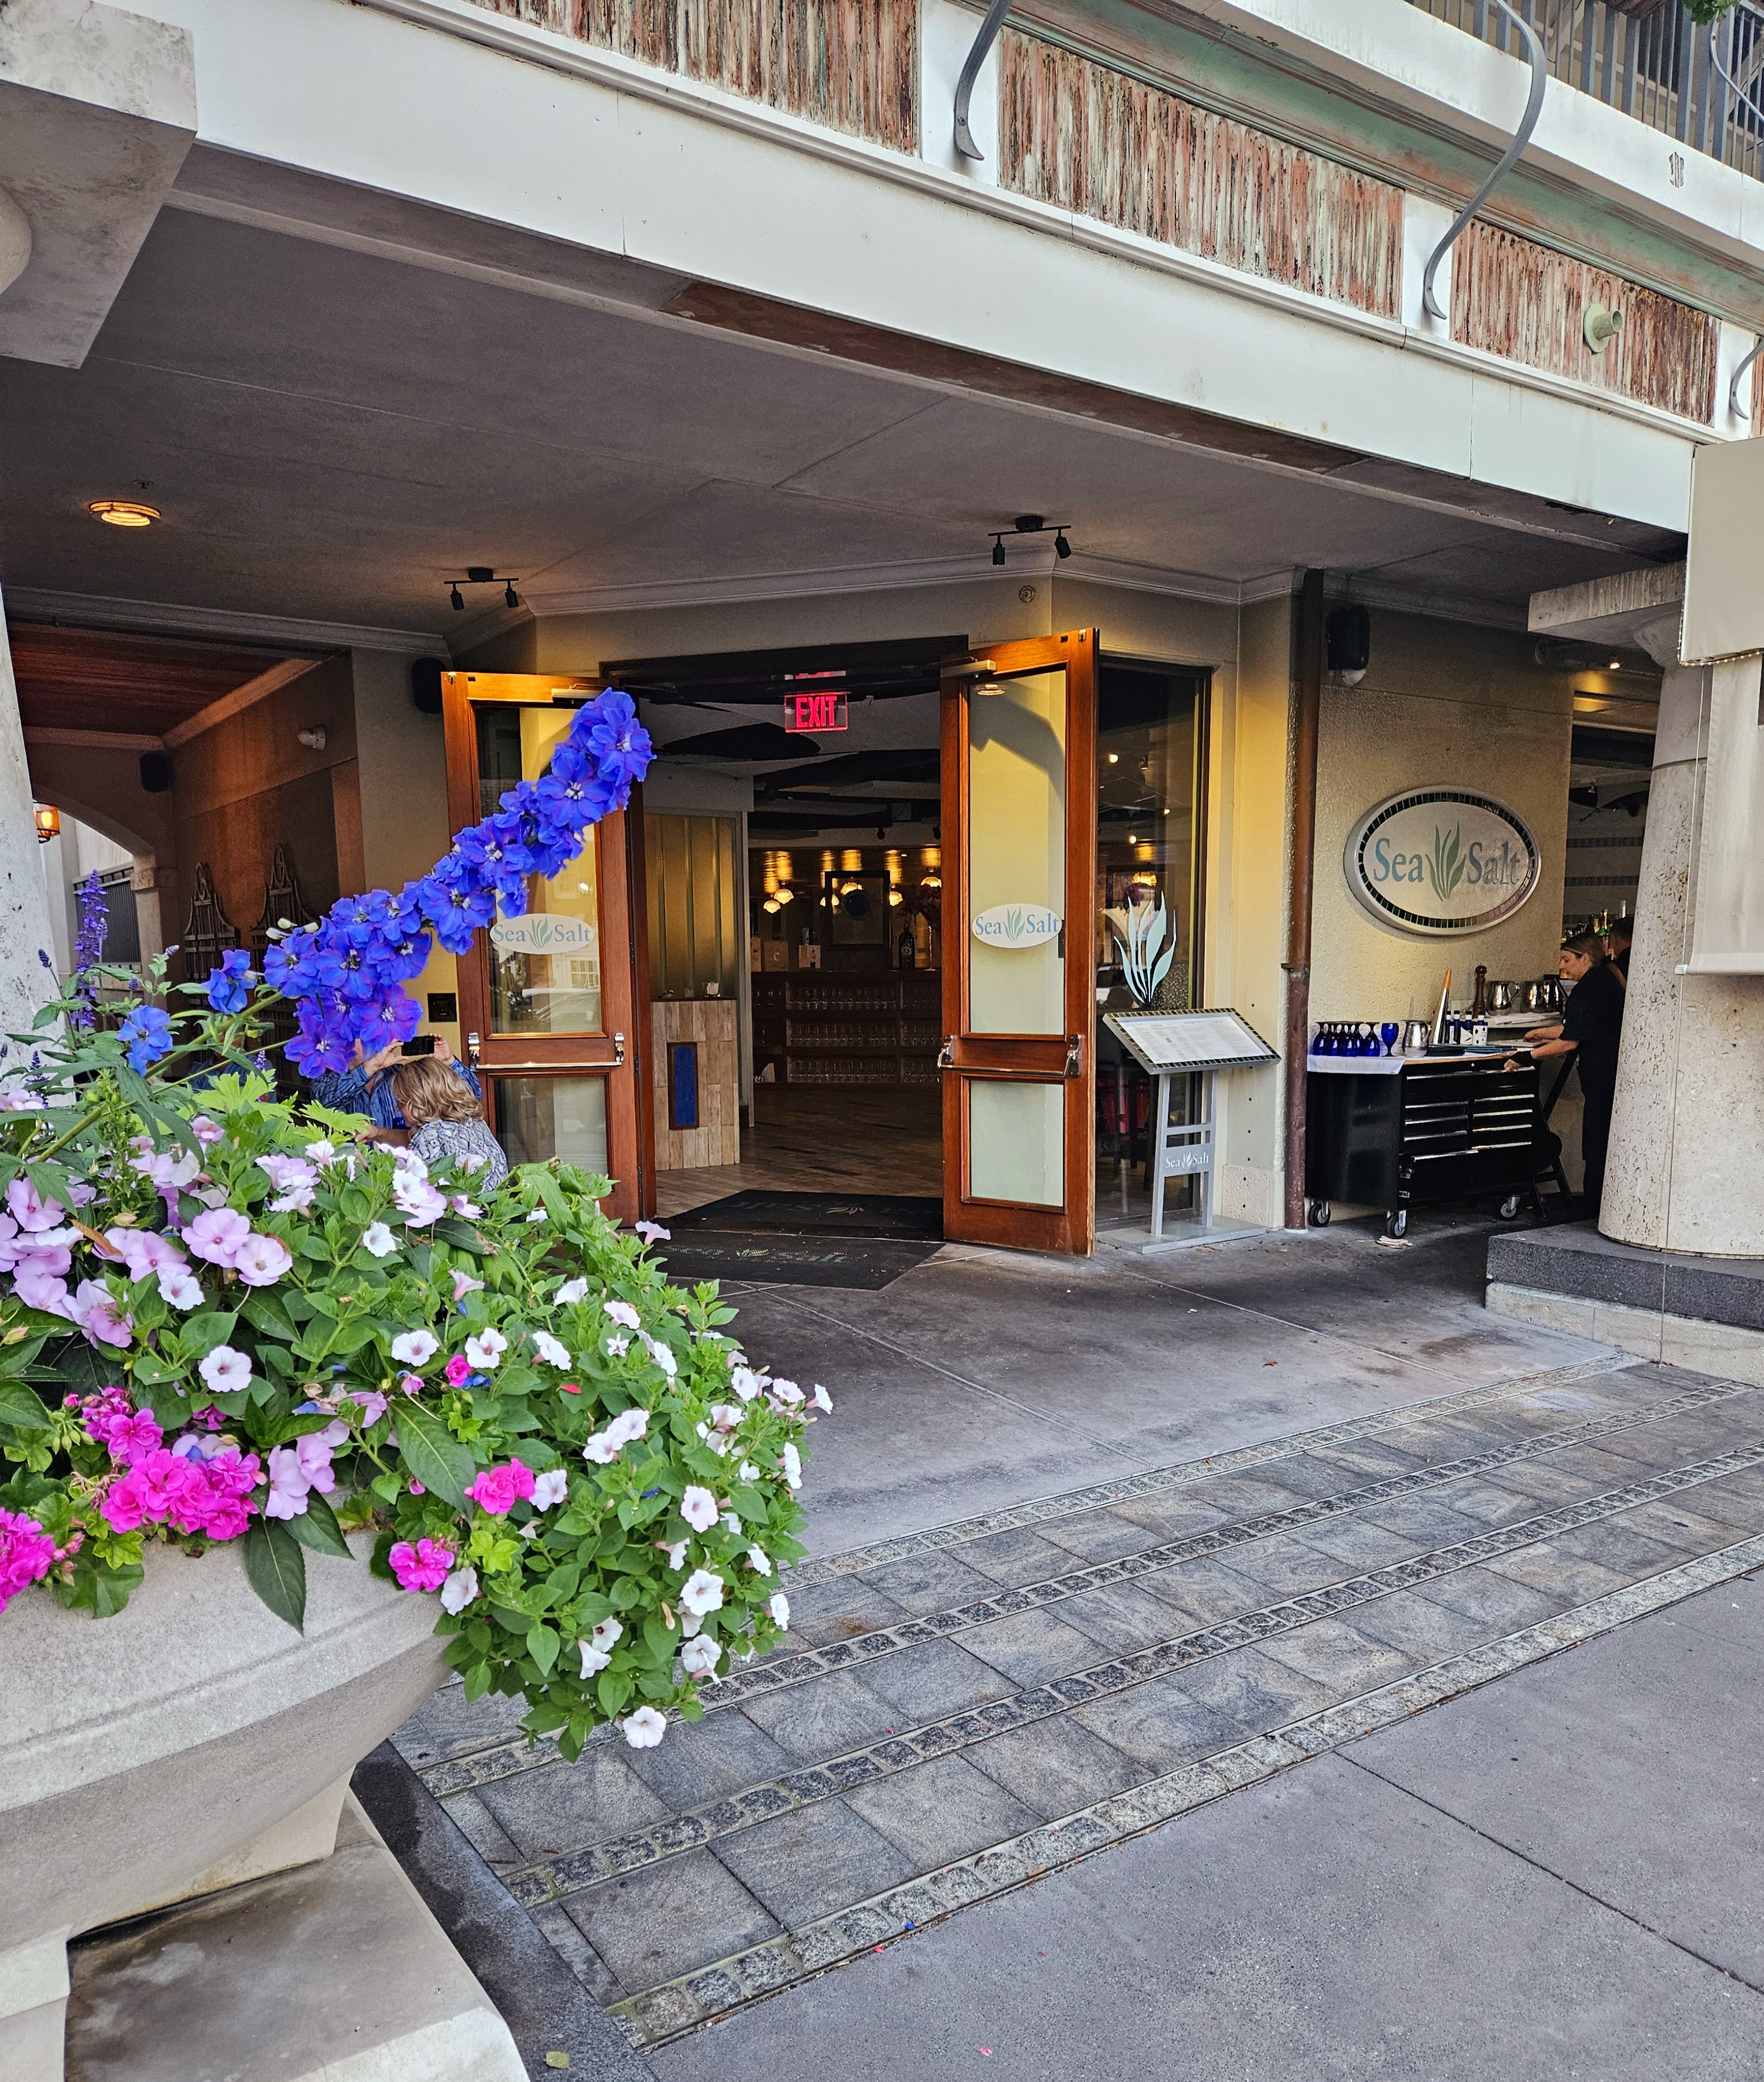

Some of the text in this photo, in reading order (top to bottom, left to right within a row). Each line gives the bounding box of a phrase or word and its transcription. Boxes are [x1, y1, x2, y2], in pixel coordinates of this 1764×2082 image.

[796, 696, 837, 728] EXIT
[1374, 838, 1521, 885] Sea Salt
[493, 923, 591, 942] Sea Salt
[975, 913, 1059, 935] Sea Salt
[1165, 1152, 1209, 1169] Sea Salt
